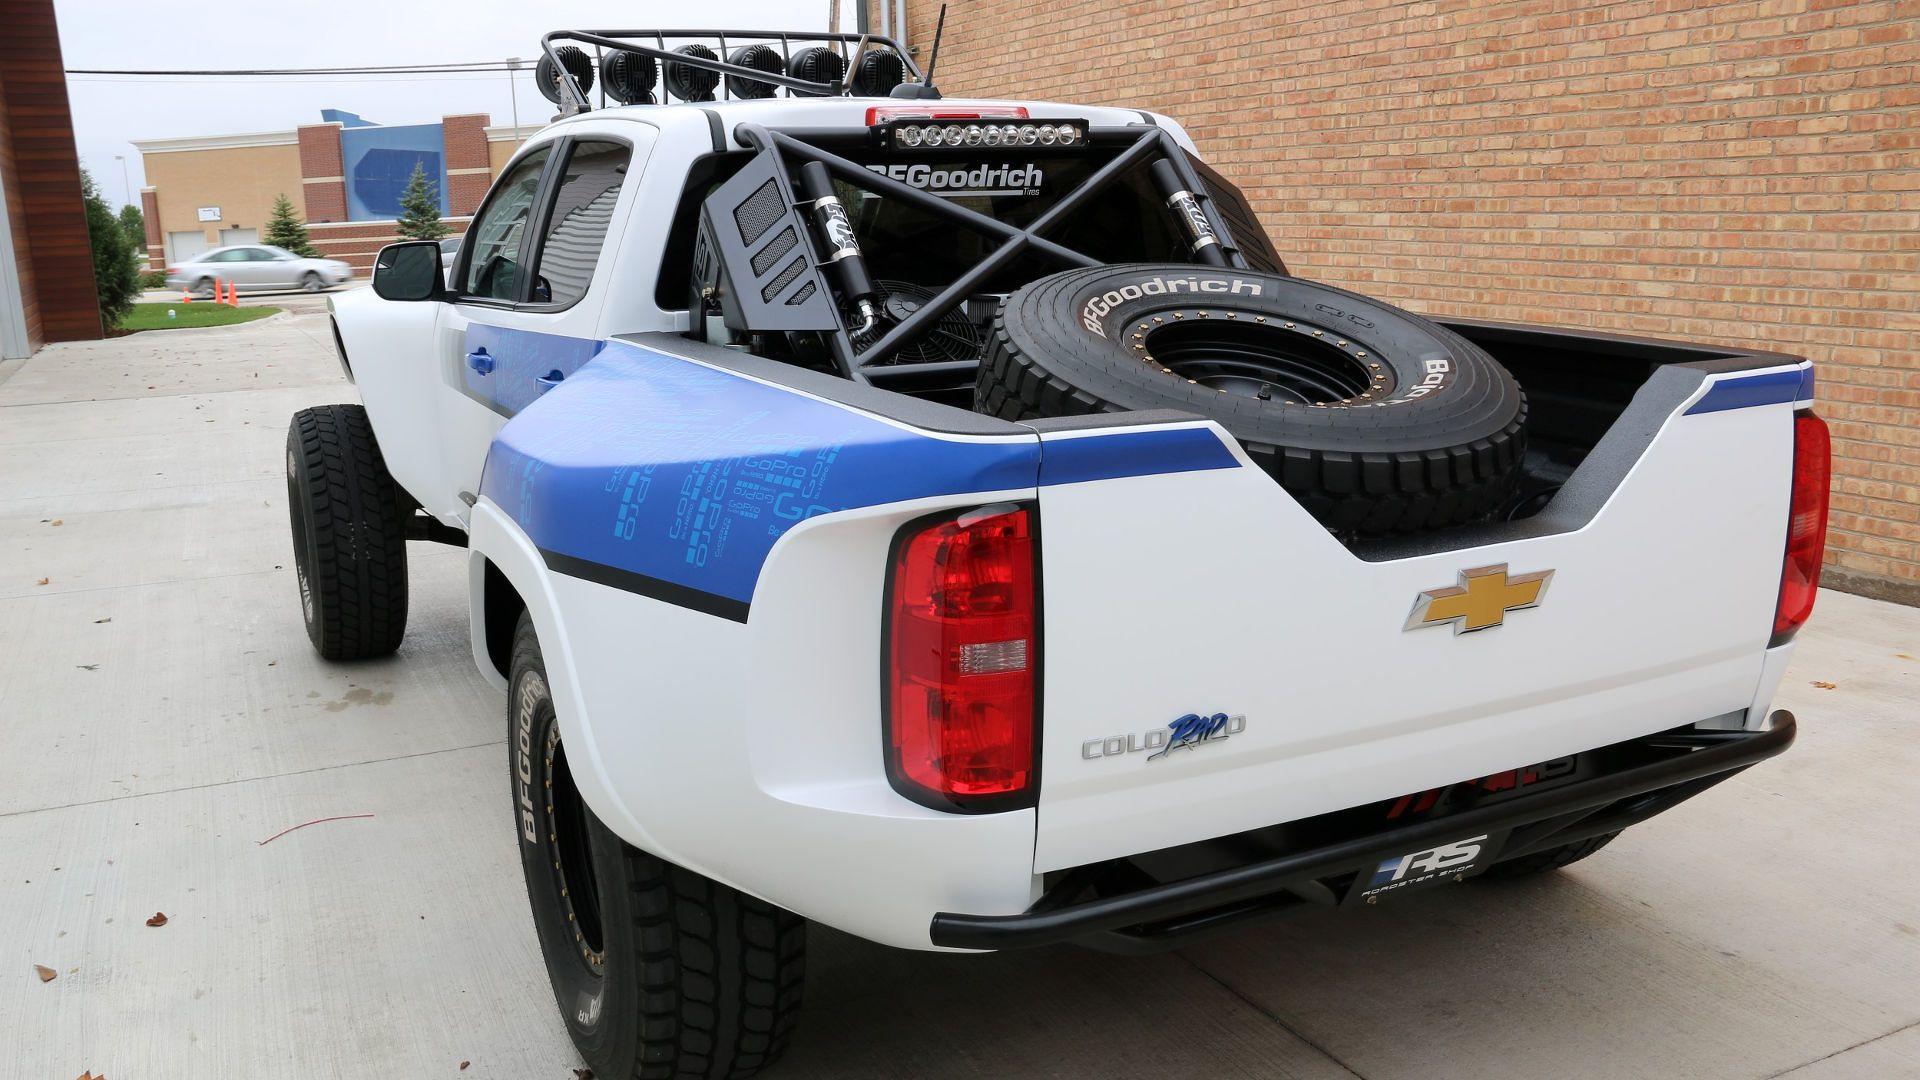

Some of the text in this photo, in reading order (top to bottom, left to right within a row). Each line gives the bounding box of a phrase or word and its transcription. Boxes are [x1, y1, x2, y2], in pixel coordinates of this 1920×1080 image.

[1023, 188, 1040, 197] Tires
[1083, 277, 1262, 340] BFGoodrich
[1403, 359, 1450, 398] Baja
[744, 456, 807, 478] GoPro
[1391, 834, 1488, 881] RS
[1438, 864, 1475, 877] SHOP
